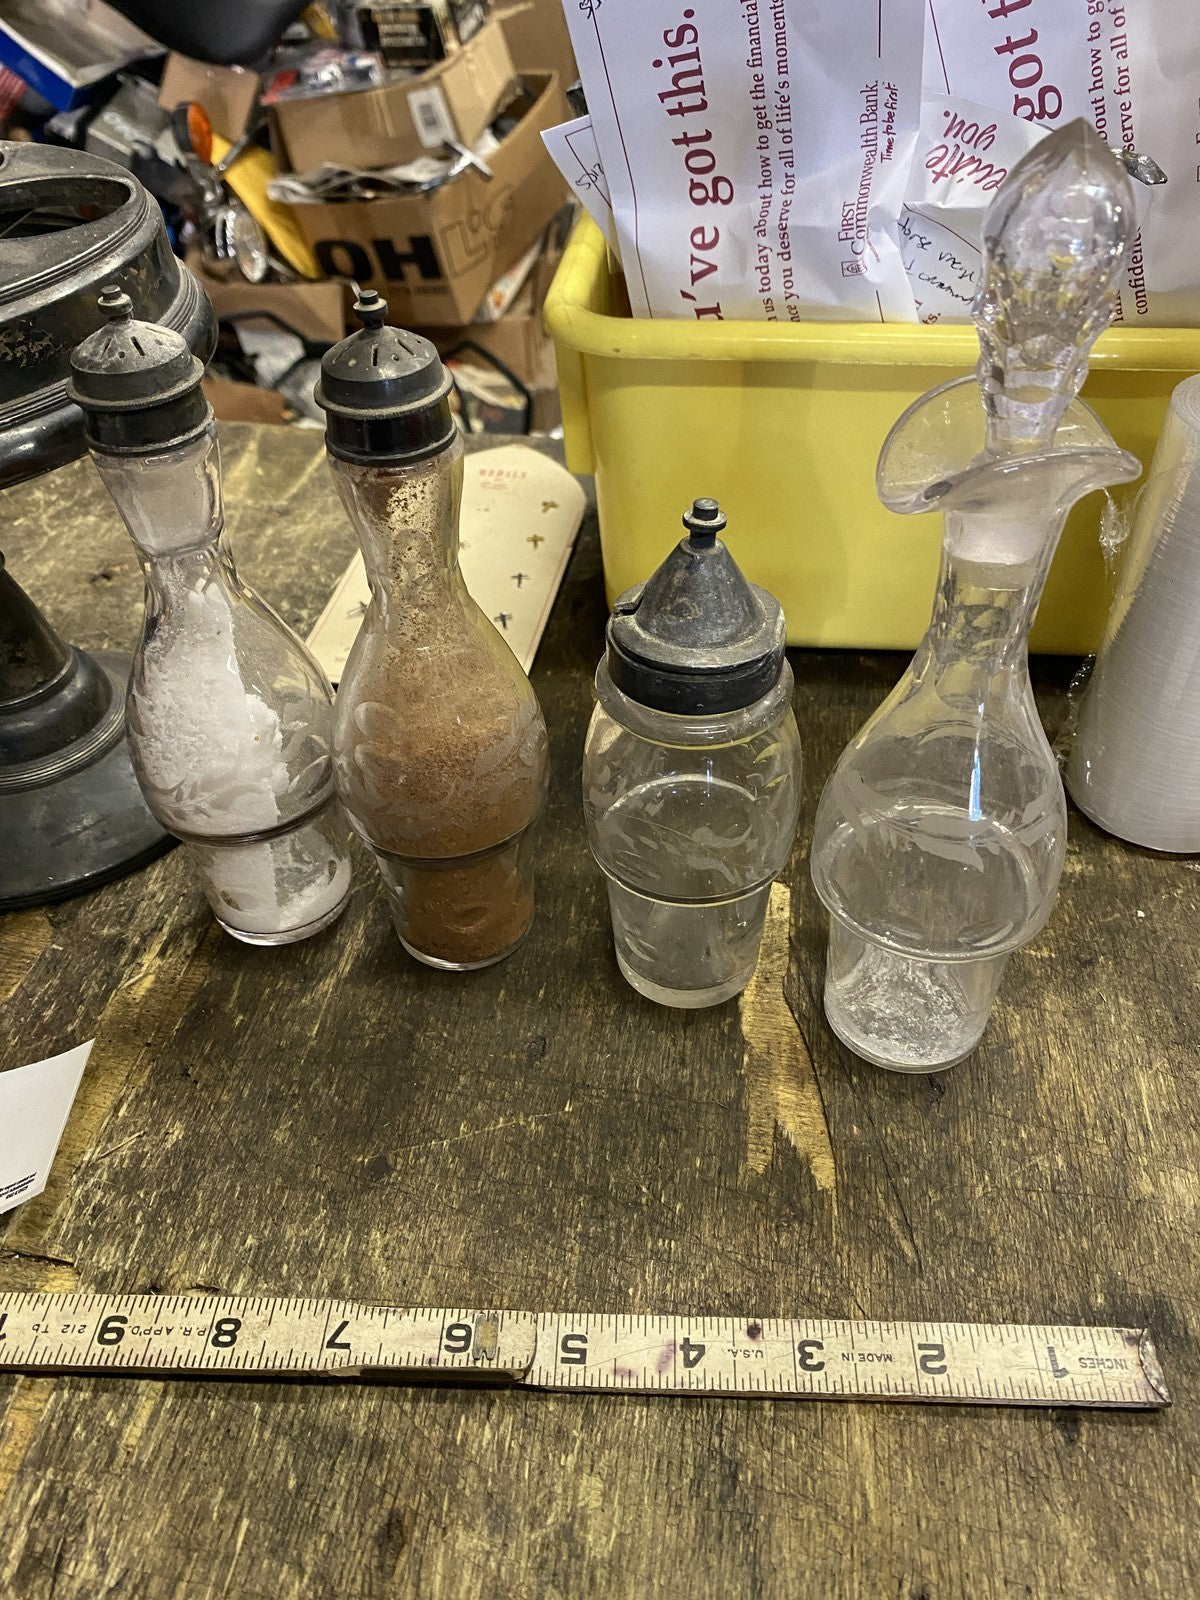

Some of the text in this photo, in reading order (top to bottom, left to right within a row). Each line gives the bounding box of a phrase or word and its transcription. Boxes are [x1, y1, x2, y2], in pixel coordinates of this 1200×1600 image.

[1086, 21, 1101, 42] to
[1108, 6, 1127, 28] of
[1110, 33, 1128, 60] all
[652, 8, 709, 117] this.
[993, 28, 1063, 122] got
[1087, 48, 1104, 93] how
[1113, 66, 1131, 96] for
[774, 80, 791, 123] life's
[881, 110, 896, 124] be
[776, 128, 793, 144] of
[882, 124, 896, 135] to
[943, 110, 998, 151] you.
[1090, 96, 1109, 145] bout
[741, 0, 775, 313] us today about how to get the financial
[778, 148, 794, 169] all
[880, 134, 896, 164] Time
[671, 129, 734, 206] got
[851, 80, 879, 256] Commonwealth Bank.
[781, 172, 796, 195] for
[777, 199, 792, 261] deserve
[838, 202, 855, 242] FIRST
[782, 267, 799, 301] you
[97, 1315, 129, 1346] 9
[211, 1318, 242, 1348] 8
[326, 1320, 351, 1350] 7
[444, 1323, 472, 1353] 6
[560, 1333, 588, 1365] 5
[679, 1337, 706, 1369] 4
[726, 1348, 764, 1360] U.S.A.
[797, 1339, 826, 1372] 3
[841, 1352, 893, 1364] MADE IN
[917, 1343, 948, 1375] 2
[1046, 1345, 1070, 1378] 1
[1078, 1356, 1129, 1371] INCHES
